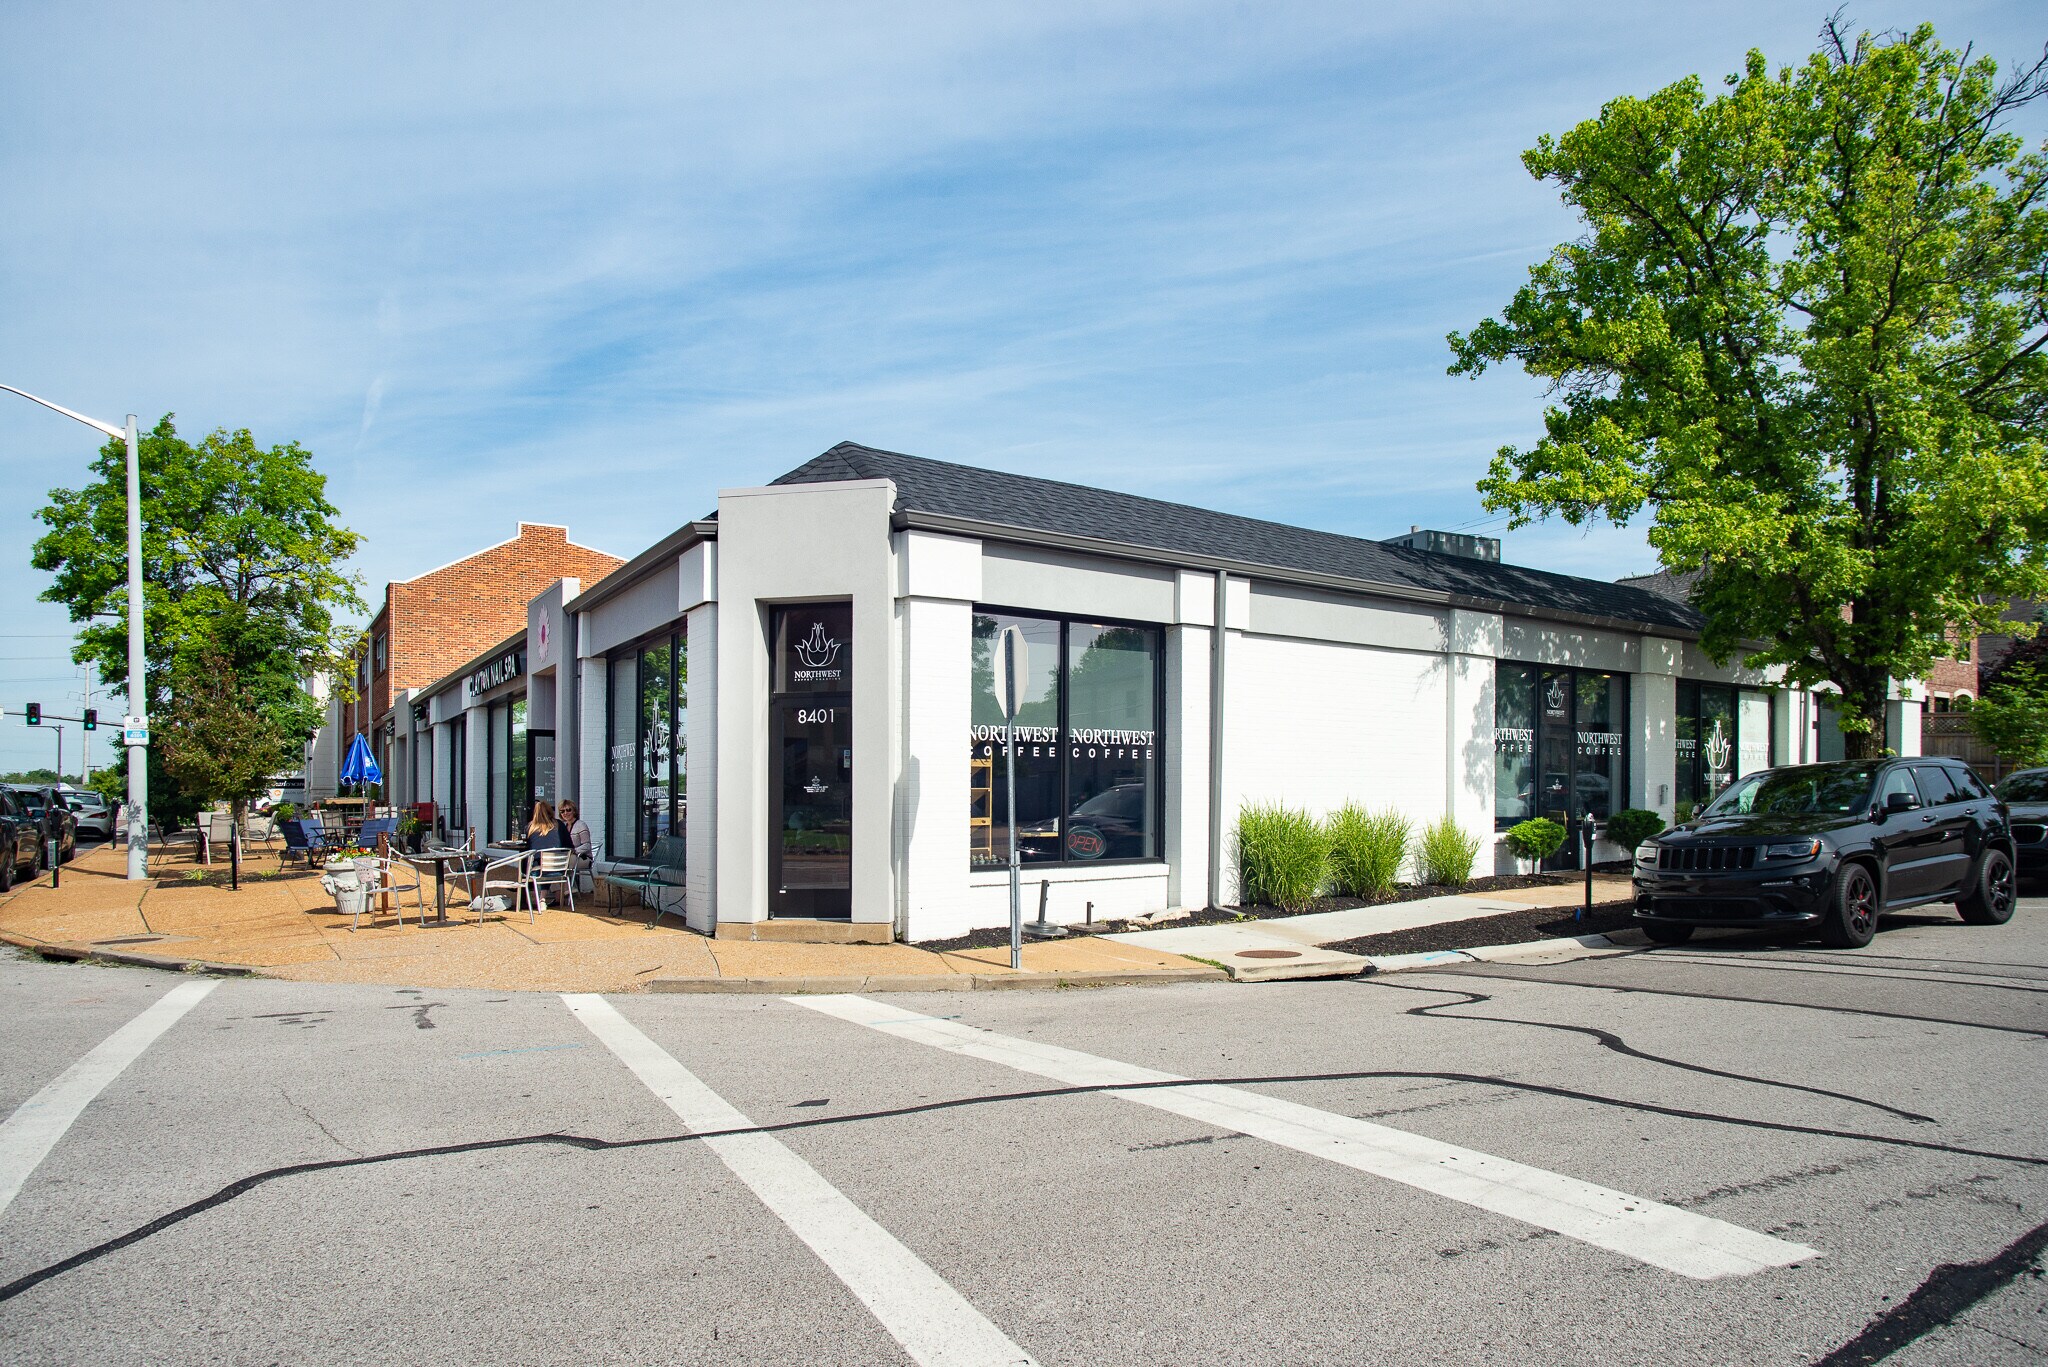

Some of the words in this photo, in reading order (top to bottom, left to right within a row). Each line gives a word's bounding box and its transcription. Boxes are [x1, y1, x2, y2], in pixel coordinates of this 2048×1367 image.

[490, 659, 505, 688] NAIL
[504, 653, 517, 681] SPA
[794, 670, 841, 679] NORTHWEST
[798, 709, 834, 724] 8401
[970, 724, 1059, 745] NORTHWEST
[1071, 728, 1155, 747] NORTHWEST
[1577, 731, 1622, 746] NORTHWEST
[1072, 747, 1152, 760] COFFEE
[1577, 746, 1622, 756] COFFEE
[1067, 833, 1104, 853] OPEN
